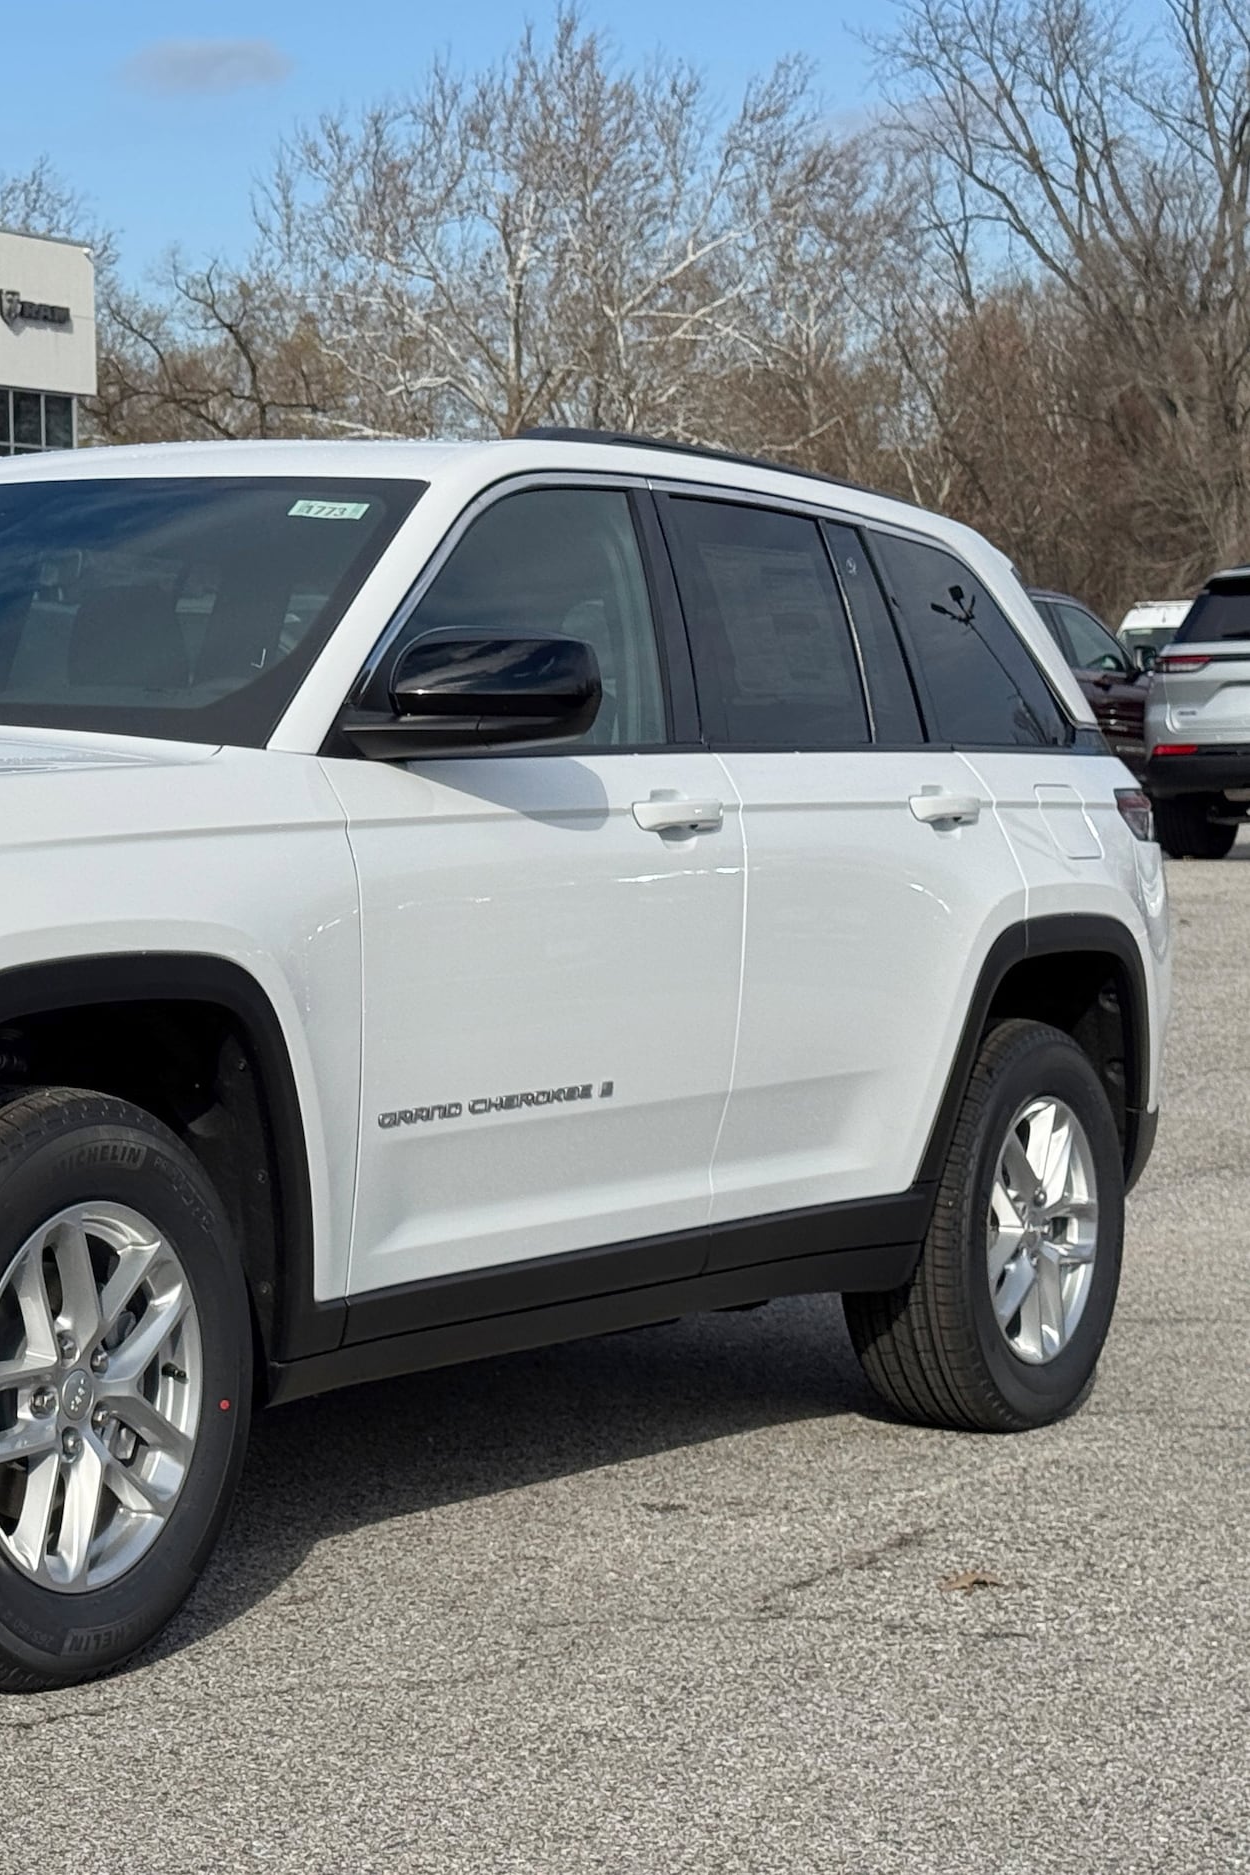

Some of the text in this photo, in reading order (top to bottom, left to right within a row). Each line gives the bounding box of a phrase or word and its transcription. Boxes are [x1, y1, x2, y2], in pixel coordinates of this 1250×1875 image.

[20, 301, 71, 324] RAM
[304, 505, 348, 517] 1773
[378, 1084, 593, 1129] GRAND CHEROKEE
